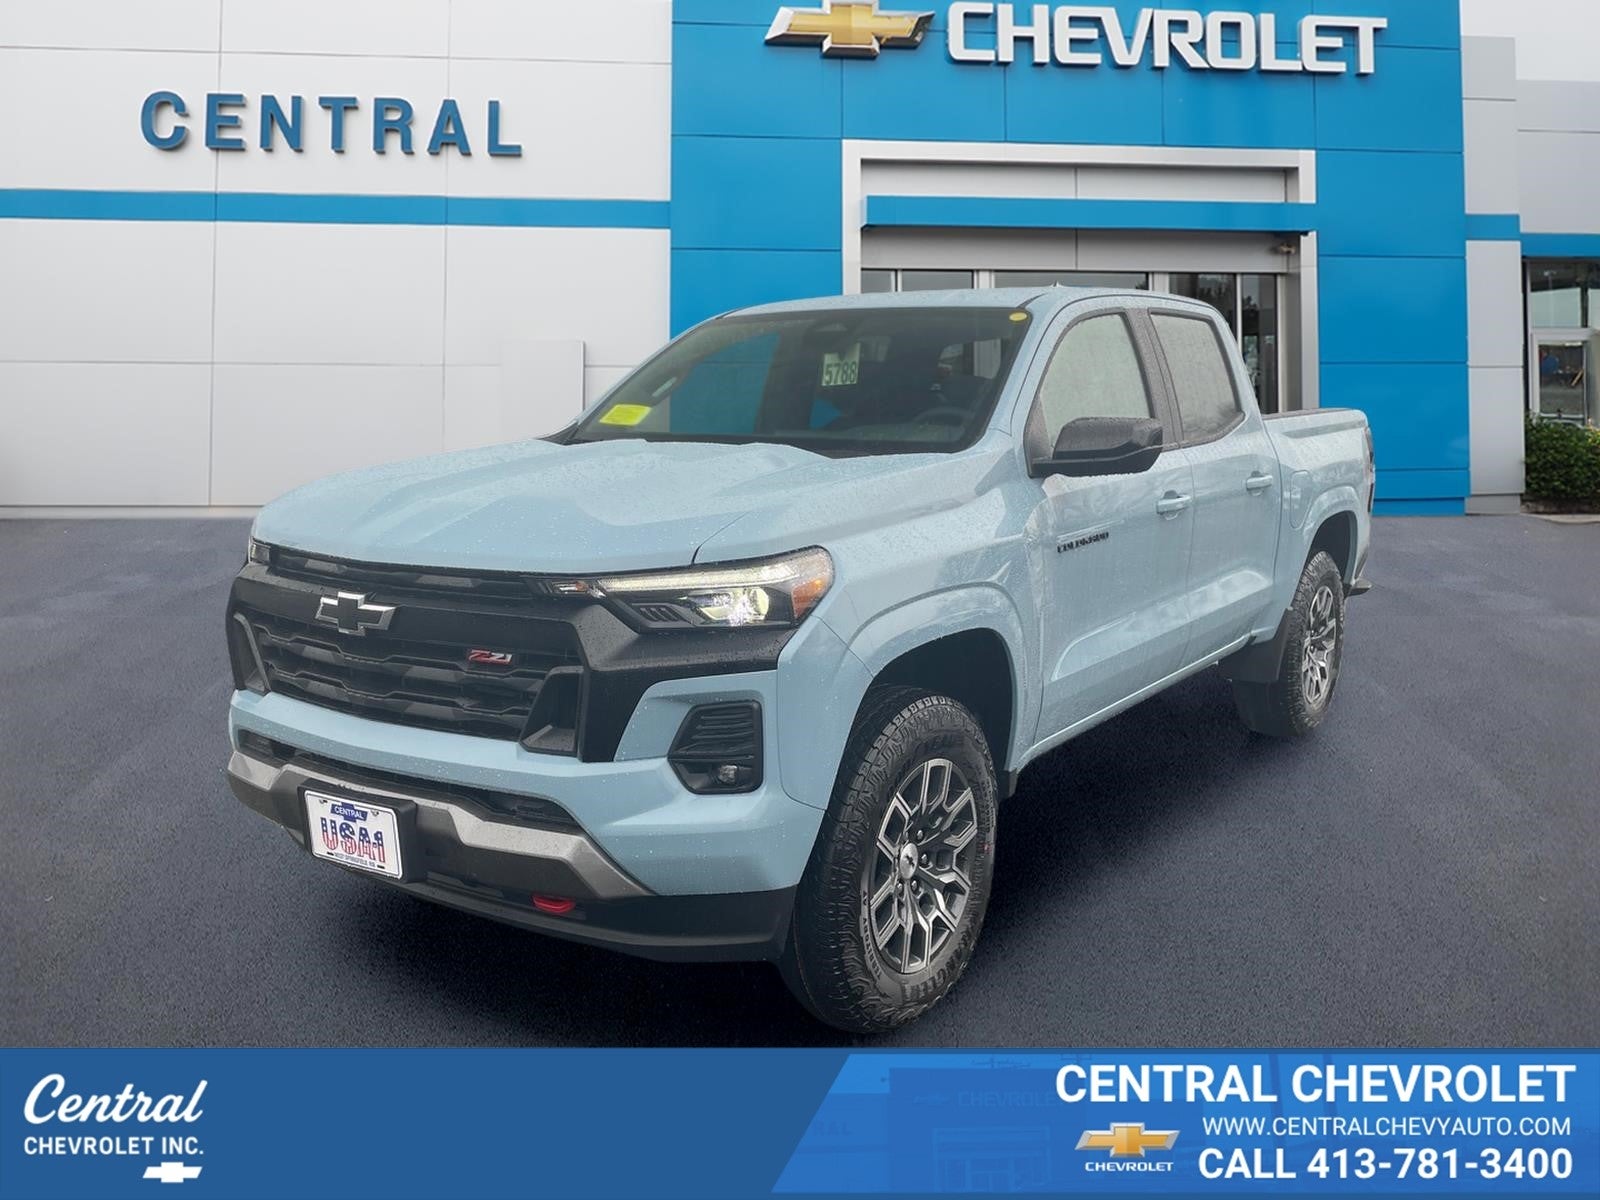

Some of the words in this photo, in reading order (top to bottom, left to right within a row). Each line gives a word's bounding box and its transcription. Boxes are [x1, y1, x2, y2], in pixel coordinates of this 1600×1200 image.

[947, 1, 1388, 75] CHEVROLET
[140, 90, 523, 157] CENTRAL
[825, 361, 857, 384] 5788
[334, 805, 365, 819] CENTRAL
